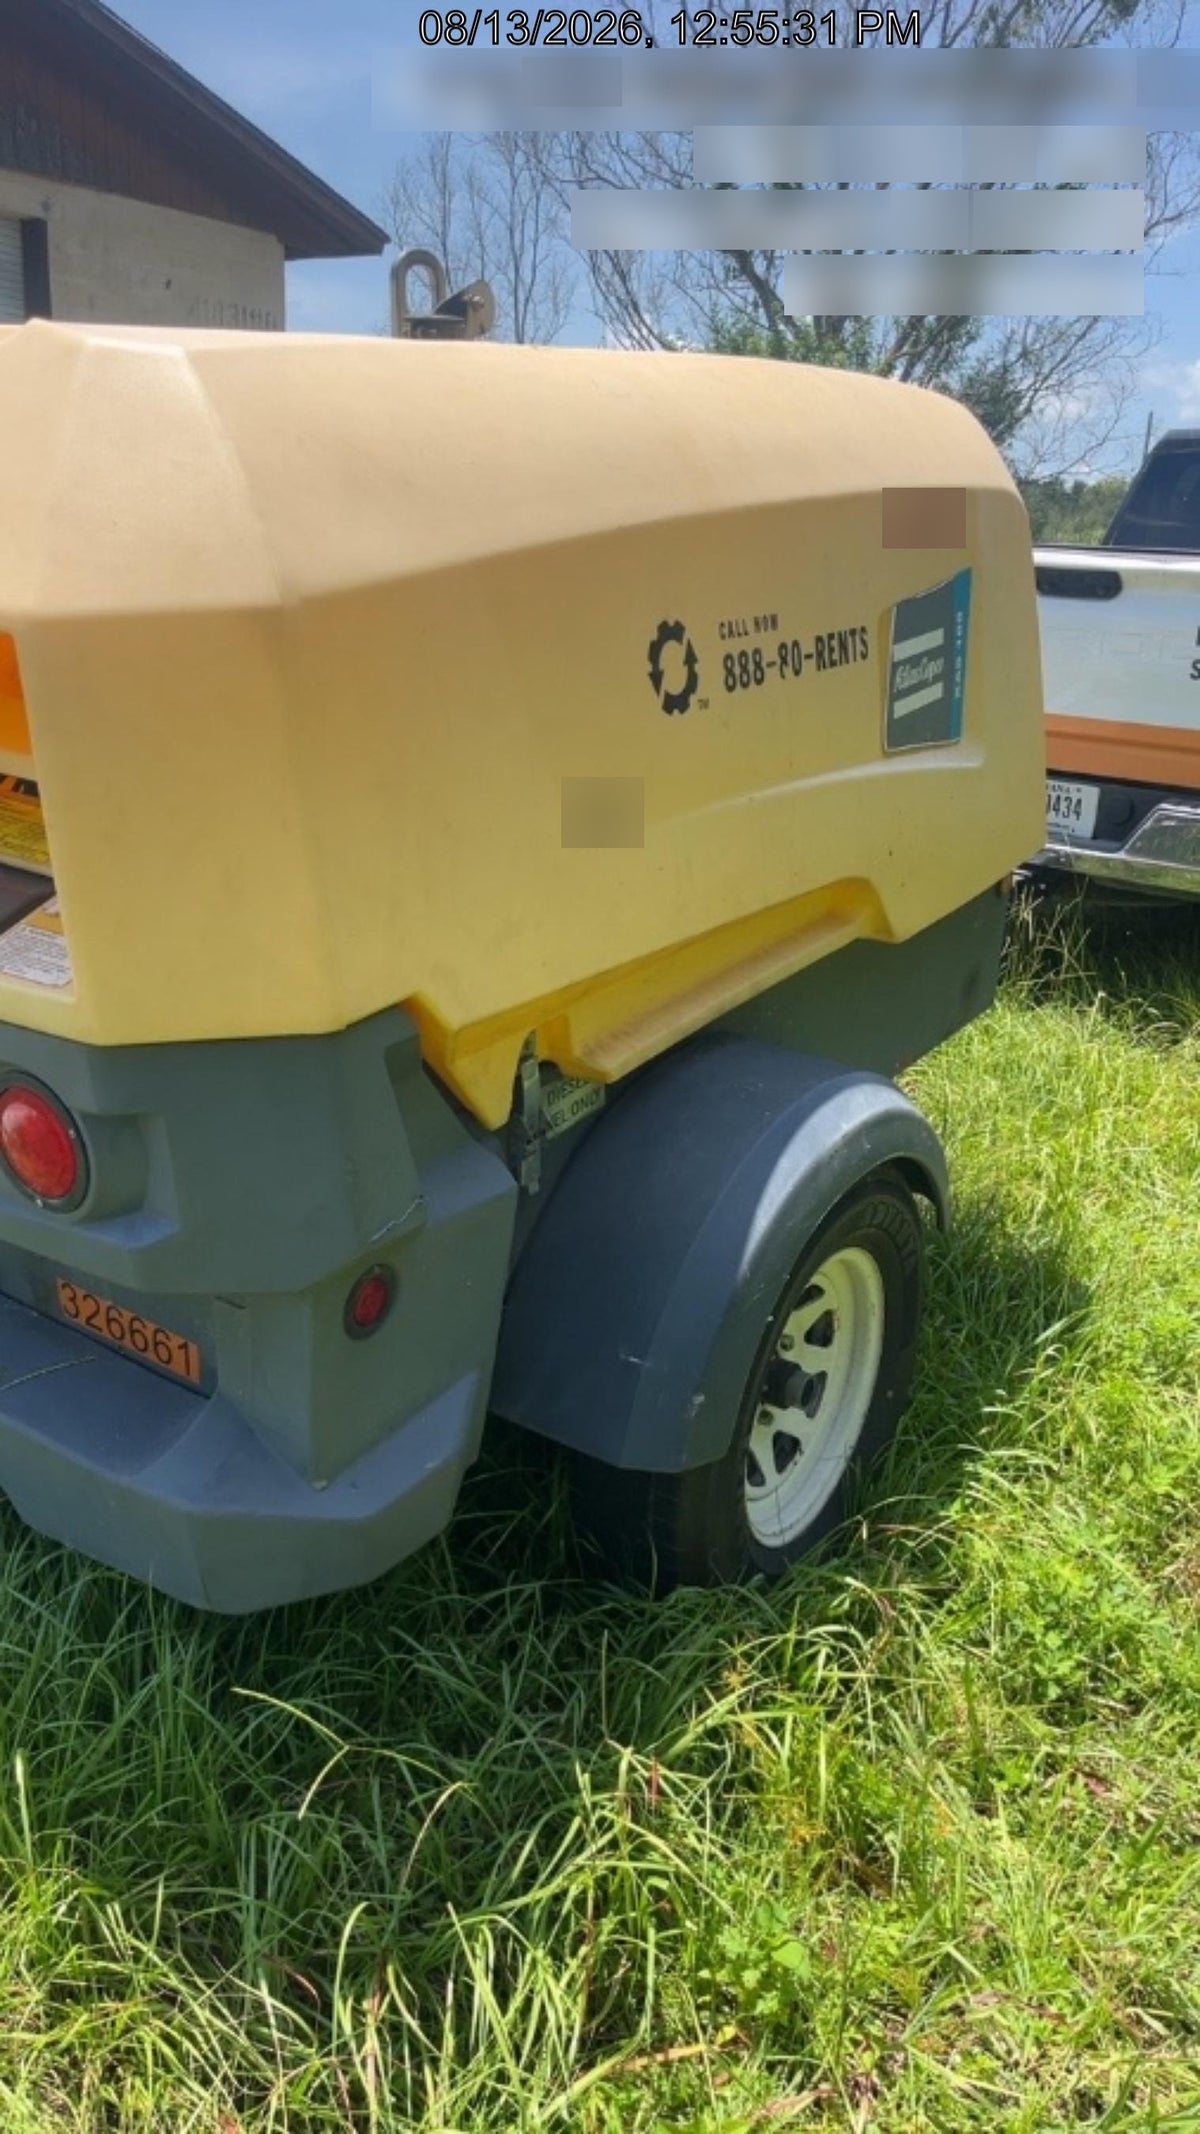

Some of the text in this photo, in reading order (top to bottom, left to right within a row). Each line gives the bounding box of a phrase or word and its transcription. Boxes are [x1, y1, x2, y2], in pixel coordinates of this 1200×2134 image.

[718, 613, 779, 641] CALL NOW
[61, 1281, 192, 1377] 326661
